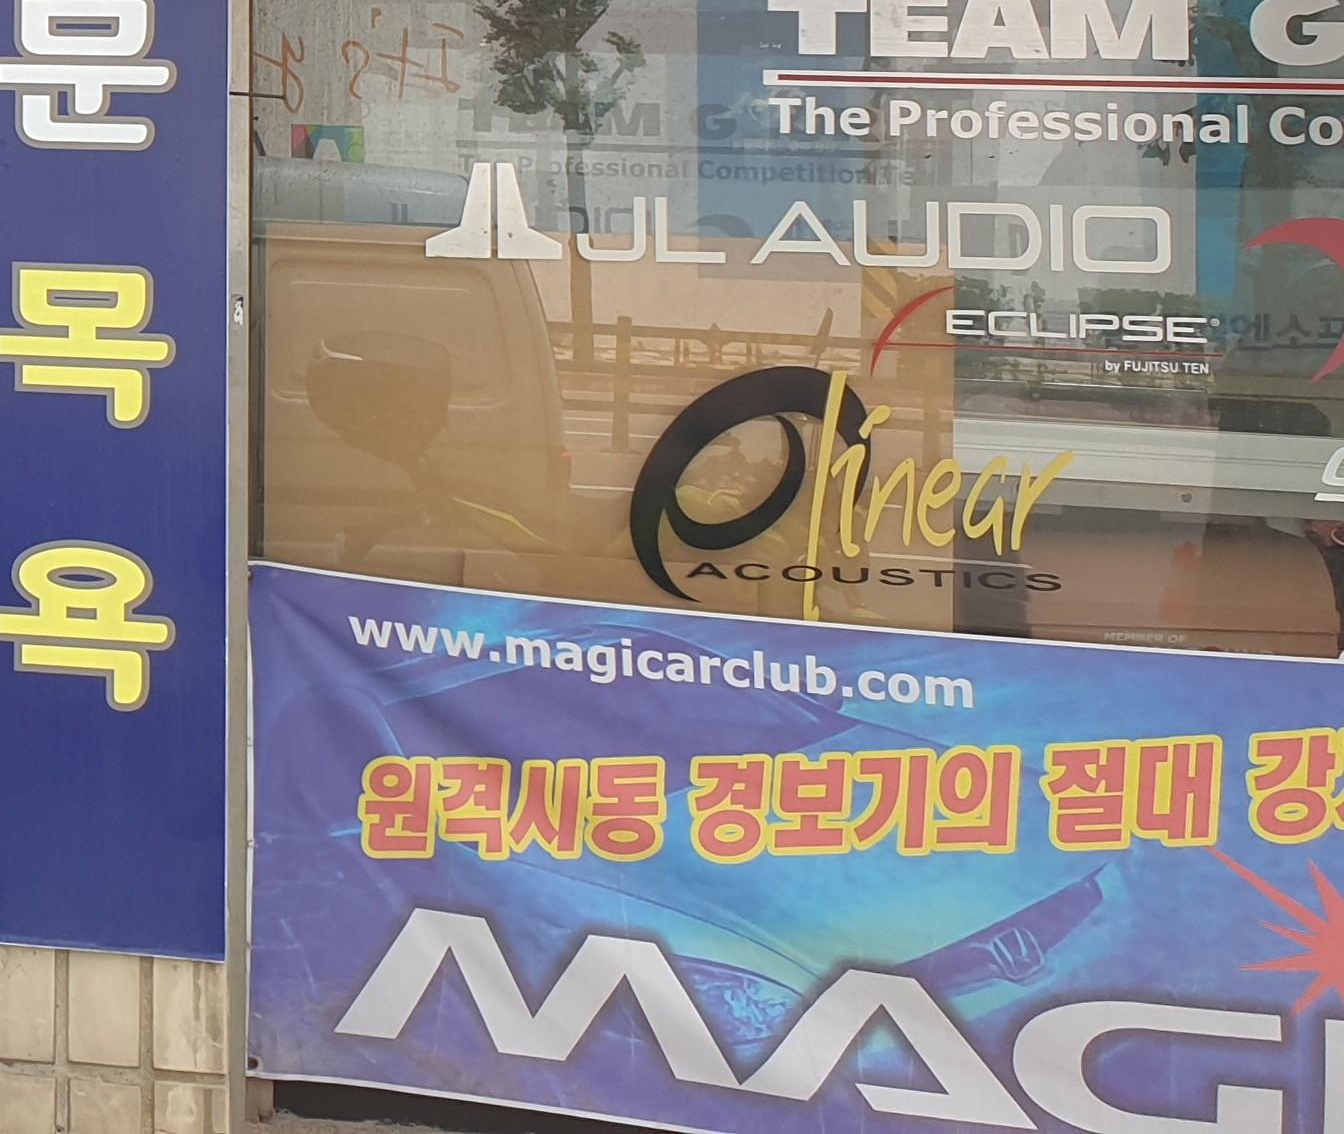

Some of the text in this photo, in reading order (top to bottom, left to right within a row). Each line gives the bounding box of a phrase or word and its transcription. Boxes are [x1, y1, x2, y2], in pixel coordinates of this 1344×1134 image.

[767, 96, 871, 137] The
[888, 100, 1250, 145] Professional
[577, 196, 1172, 274] JL AUDIO
[945, 309, 1209, 344] ECLIPSE
[1104, 359, 1210, 375] by FUJITSU TEN
[686, 560, 1063, 594] ACOUSTICS
[347, 614, 976, 710] www.magicarclub.com
[358, 727, 1344, 864] 원격시동 경보기의 절대 강
